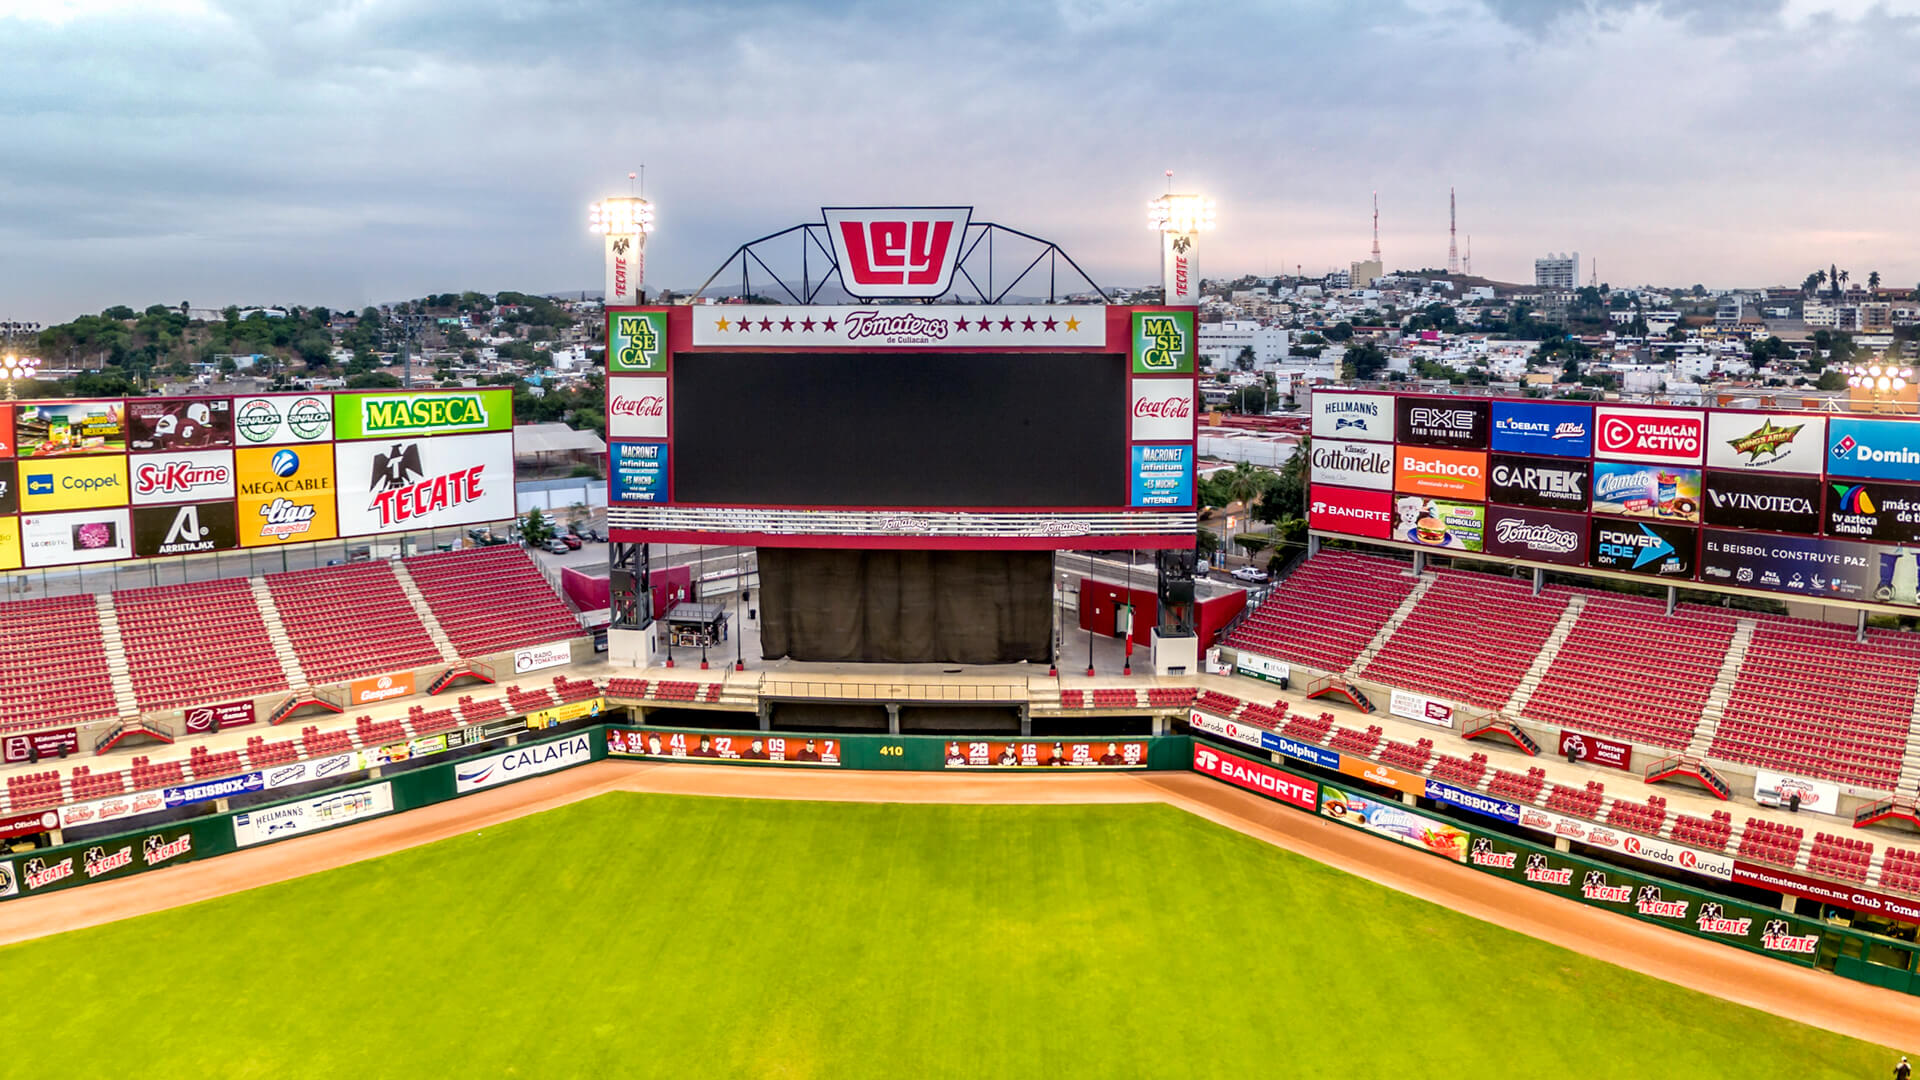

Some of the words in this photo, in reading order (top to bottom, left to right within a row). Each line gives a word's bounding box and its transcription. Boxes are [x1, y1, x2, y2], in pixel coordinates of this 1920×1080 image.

[839, 221, 954, 285] Ley
[615, 257, 627, 297] TECATE
[1176, 256, 1188, 297] TECATE
[622, 319, 649, 335] MA
[845, 311, 948, 339] Tomateros
[1146, 319, 1175, 335] MA
[631, 334, 656, 350] SE
[898, 336, 929, 344] Culiacán
[1156, 335, 1181, 351] SE
[622, 349, 647, 365] CA
[1145, 350, 1173, 366] CA
[369, 399, 482, 428] MASECA
[611, 394, 664, 417] Coca-Cola
[1134, 396, 1191, 418] Coca-Cola
[1325, 401, 1378, 417] HELLMANN'S
[238, 414, 281, 426] SINALOA
[288, 413, 330, 424] SINALOA
[1410, 407, 1474, 430] AXE
[1496, 420, 1507, 429] EL
[1510, 422, 1550, 432] DEBATE
[1412, 427, 1428, 436] FIND
[1429, 428, 1447, 437] YOUR
[1636, 424, 1697, 437] CULIACÁN
[1767, 432, 1792, 442] ARMY
[621, 445, 658, 458] MACRONET
[1636, 438, 1697, 451] ACTIVO
[1143, 448, 1183, 462] MACRONET
[1313, 447, 1390, 474] Cottonelle
[1403, 456, 1479, 477] Bachoco
[62, 473, 121, 492] Coppel
[138, 464, 228, 493] SuKarne
[240, 478, 329, 495] MEGACABLE
[1492, 465, 1583, 493] CARTEK
[1596, 470, 1649, 496] Clamato
[369, 464, 485, 528] TECATE
[621, 492, 655, 500] INTERNET
[1142, 496, 1178, 505] INTERNET
[1539, 490, 1582, 500] AUTOPARTES
[1726, 492, 1815, 515] VINOTECA
[1328, 505, 1391, 522] BANORTE
[1832, 513, 1844, 522] tv
[1844, 515, 1878, 526] azteca
[1897, 511, 1912, 522] de
[880, 517, 929, 530] Tomateros
[1040, 520, 1090, 533] Tomateros
[1835, 522, 1873, 535] sinaloa
[1496, 518, 1578, 552] Tomateros
[1599, 530, 1663, 549] POWER
[159, 541, 215, 554] ARRIETA.MX
[1707, 542, 1719, 552] EL
[1723, 544, 1768, 557] BEISBOL
[1771, 549, 1841, 565] CONSTRUYE
[1844, 555, 1869, 568] PAZ.
[1192, 712, 1224, 734] Kuroda
[1226, 723, 1260, 745] Kuroda
[627, 733, 643, 747] 31
[670, 734, 686, 748] 41
[715, 737, 732, 751] 27
[768, 738, 785, 752] 09
[824, 741, 834, 754] 7
[1595, 740, 1625, 754] Viernes
[502, 737, 589, 771] CALAFIA
[879, 746, 904, 756] 410
[1021, 743, 1037, 758] 16
[1280, 739, 1318, 762] Dolphy
[1598, 750, 1620, 760] social
[184, 779, 244, 800] BEISBOX
[1220, 761, 1315, 805] BANORTE
[1442, 788, 1502, 814] BEISBOX
[256, 805, 304, 827] HELLMANN'S
[143, 834, 191, 866] TECATE
[1624, 837, 1675, 863] Kuroda
[1678, 850, 1731, 877] Kuroda
[84, 846, 132, 878] TECATE
[1472, 851, 1517, 869] TECATE
[24, 858, 74, 890] TECATE
[1525, 867, 1574, 885] TECATE
[1582, 884, 1633, 904] TECATE
[1734, 866, 1849, 901] www.tomateros.com.mx
[1852, 893, 1881, 909] Club
[1637, 899, 1689, 919] TECATE
[1697, 917, 1752, 936] TECATE
[1761, 934, 1819, 954] TECATE
